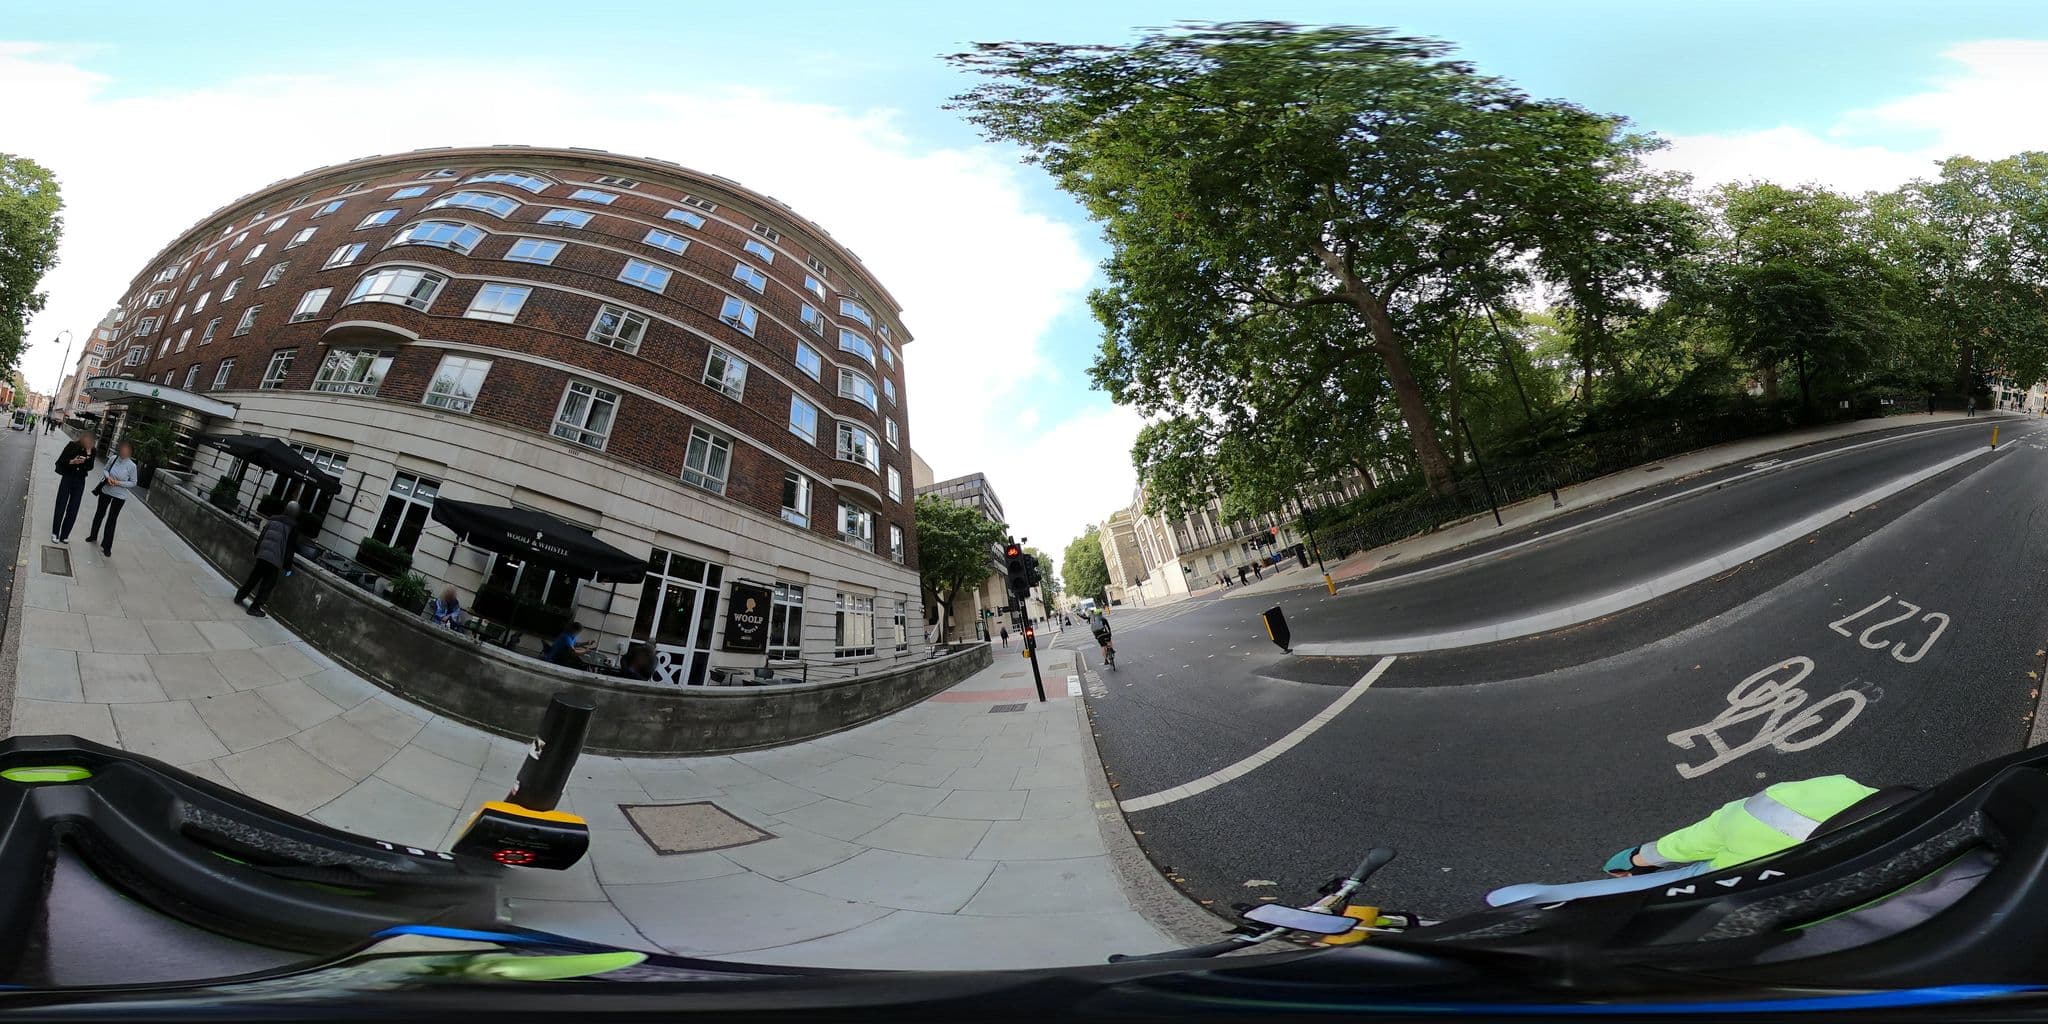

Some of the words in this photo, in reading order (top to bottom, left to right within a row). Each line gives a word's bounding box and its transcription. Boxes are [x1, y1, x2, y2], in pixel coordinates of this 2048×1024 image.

[99, 380, 129, 391] HOTEL
[734, 613, 764, 624] WOOLF
[1828, 595, 1950, 663] C27
